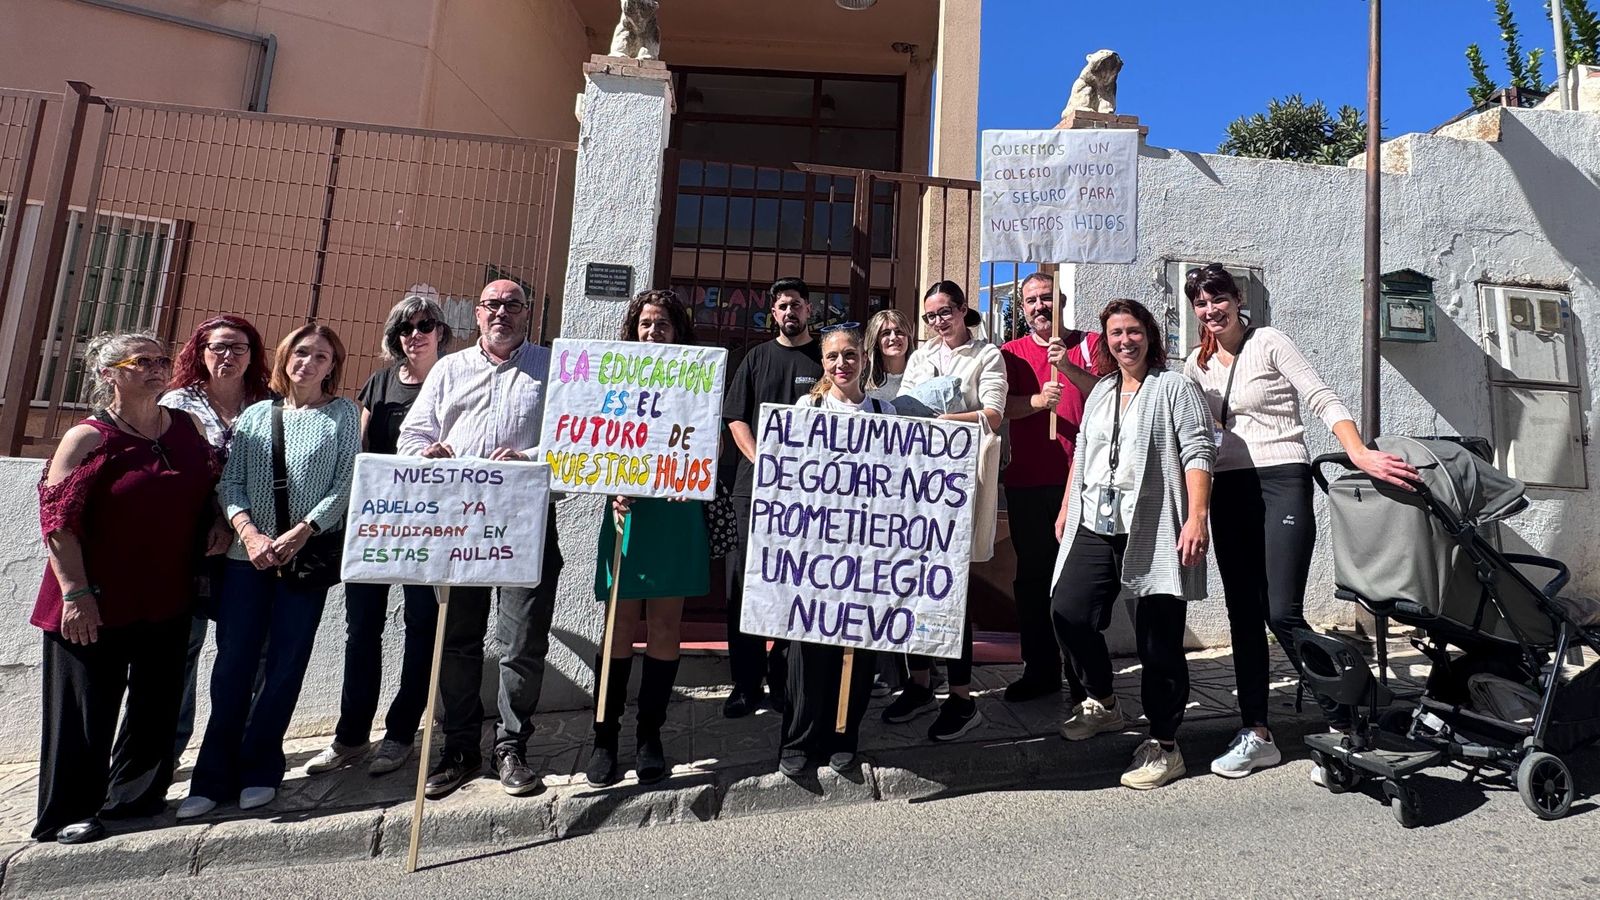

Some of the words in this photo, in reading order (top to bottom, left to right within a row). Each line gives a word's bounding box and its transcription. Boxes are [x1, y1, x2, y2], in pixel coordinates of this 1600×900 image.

[991, 144, 1065, 156] QUEREMOS
[1089, 142, 1110, 154] UN
[995, 166, 1051, 180] COLEGIO
[1068, 163, 1114, 176] NUEVO
[992, 191, 1005, 205] Y
[1012, 188, 1066, 204] SEGURO
[1079, 186, 1115, 200] PARA
[991, 216, 1064, 232] NUESTROS
[560, 350, 590, 384] LA
[601, 390, 630, 416] ES
[636, 391, 662, 418] EL
[555, 414, 649, 449] FUTURO
[668, 424, 695, 450] DE
[763, 409, 804, 448] AL
[808, 413, 972, 460] ALUMNADO
[393, 467, 504, 485] NUESTROS
[546, 450, 653, 487] NUESTROS
[757, 454, 798, 491] DE
[799, 453, 892, 498] GÓJAR
[901, 468, 969, 508] NOS
[362, 499, 440, 516] ABUELOS
[461, 501, 486, 516] YA
[358, 524, 469, 538] ESTUDIABAN
[483, 525, 508, 539] EN
[362, 547, 429, 563] ESTAS
[449, 545, 514, 561] AULAS
[761, 547, 809, 587] UN
[788, 594, 915, 644] NUEVO
